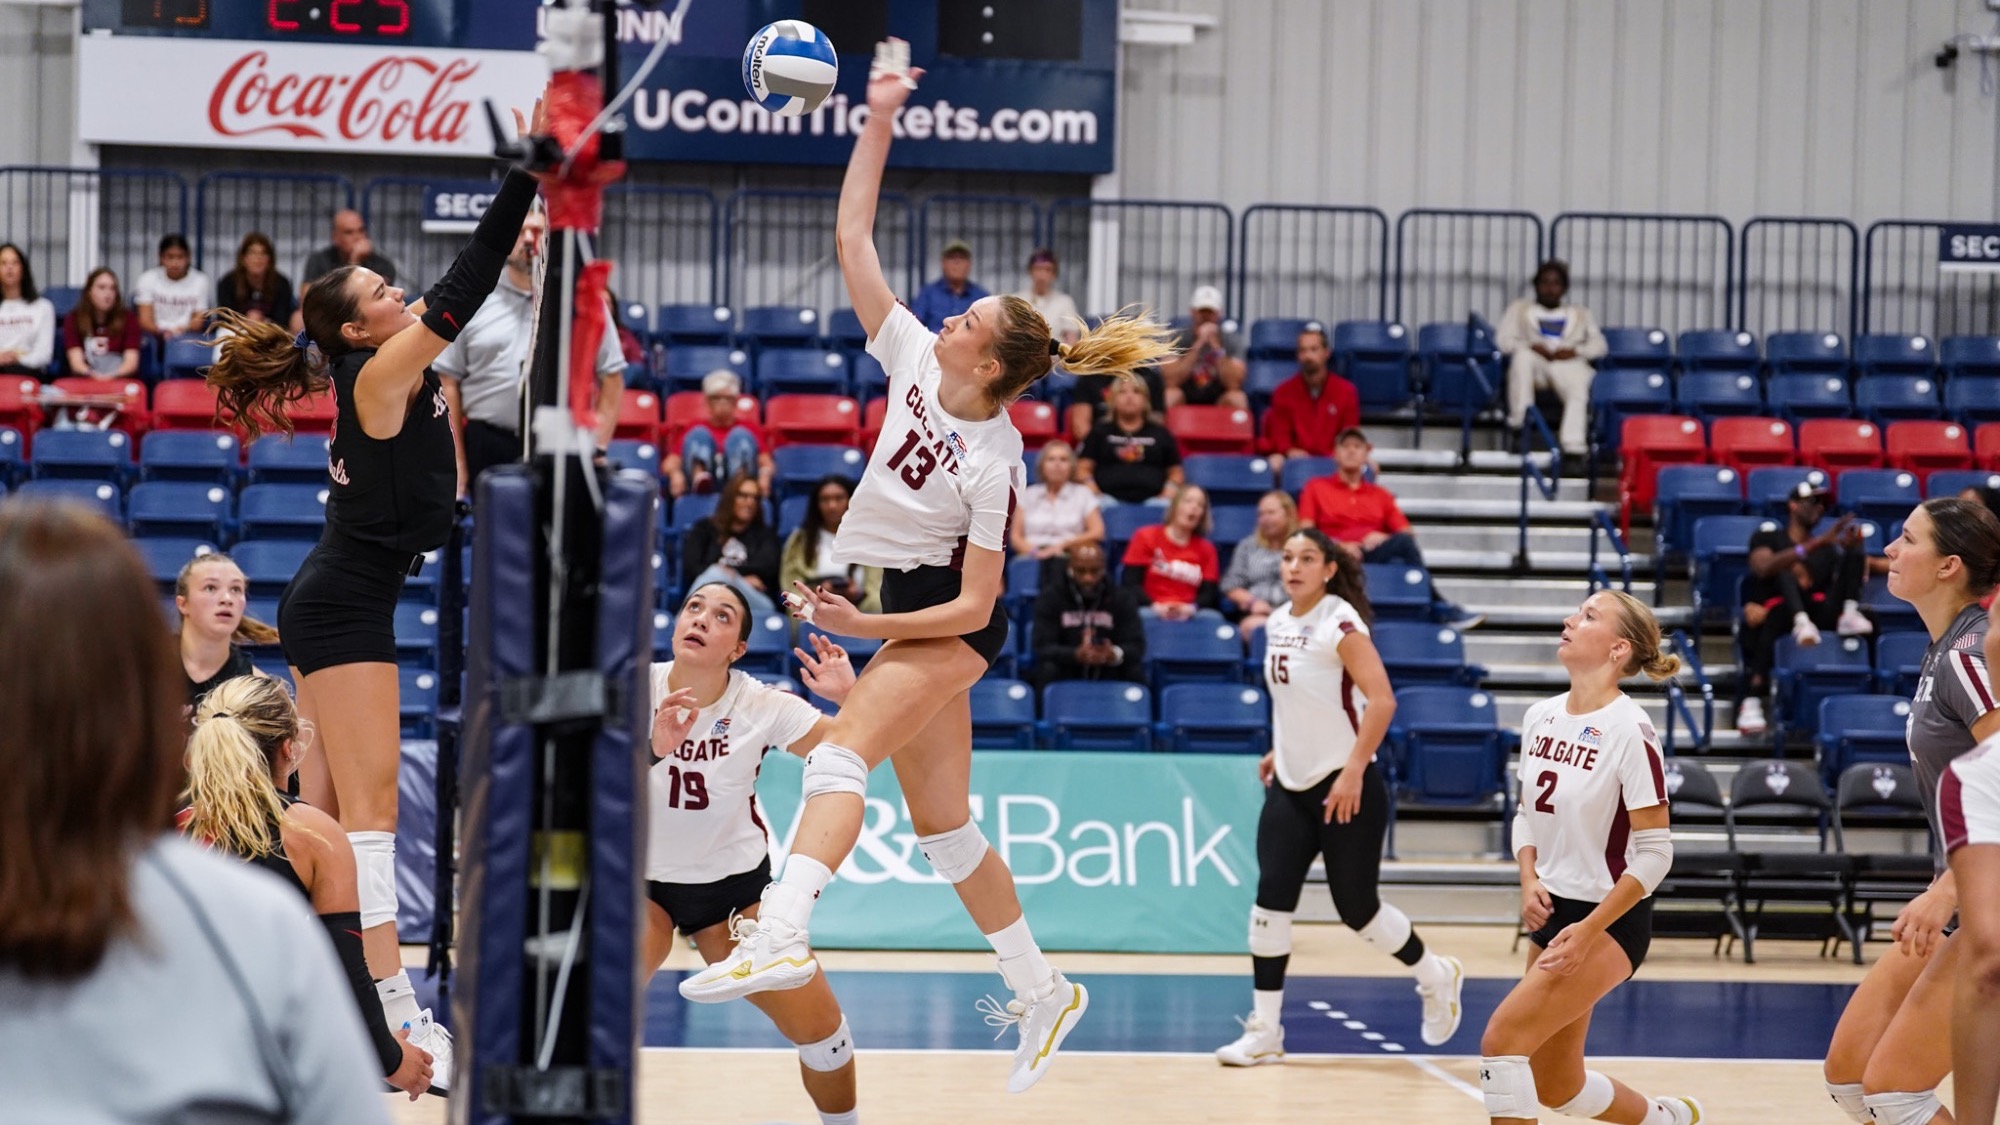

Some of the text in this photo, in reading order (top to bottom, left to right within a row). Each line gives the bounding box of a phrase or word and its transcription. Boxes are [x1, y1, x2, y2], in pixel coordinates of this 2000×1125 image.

[752, 35, 769, 88] molten
[208, 50, 481, 142] Coca-Cola
[886, 428, 937, 491] 13
[1271, 654, 1290, 685] 15
[1528, 734, 1599, 771] COLGATE
[668, 765, 710, 811] 19
[1535, 769, 1559, 815] 2
[997, 794, 1241, 887] Bank
